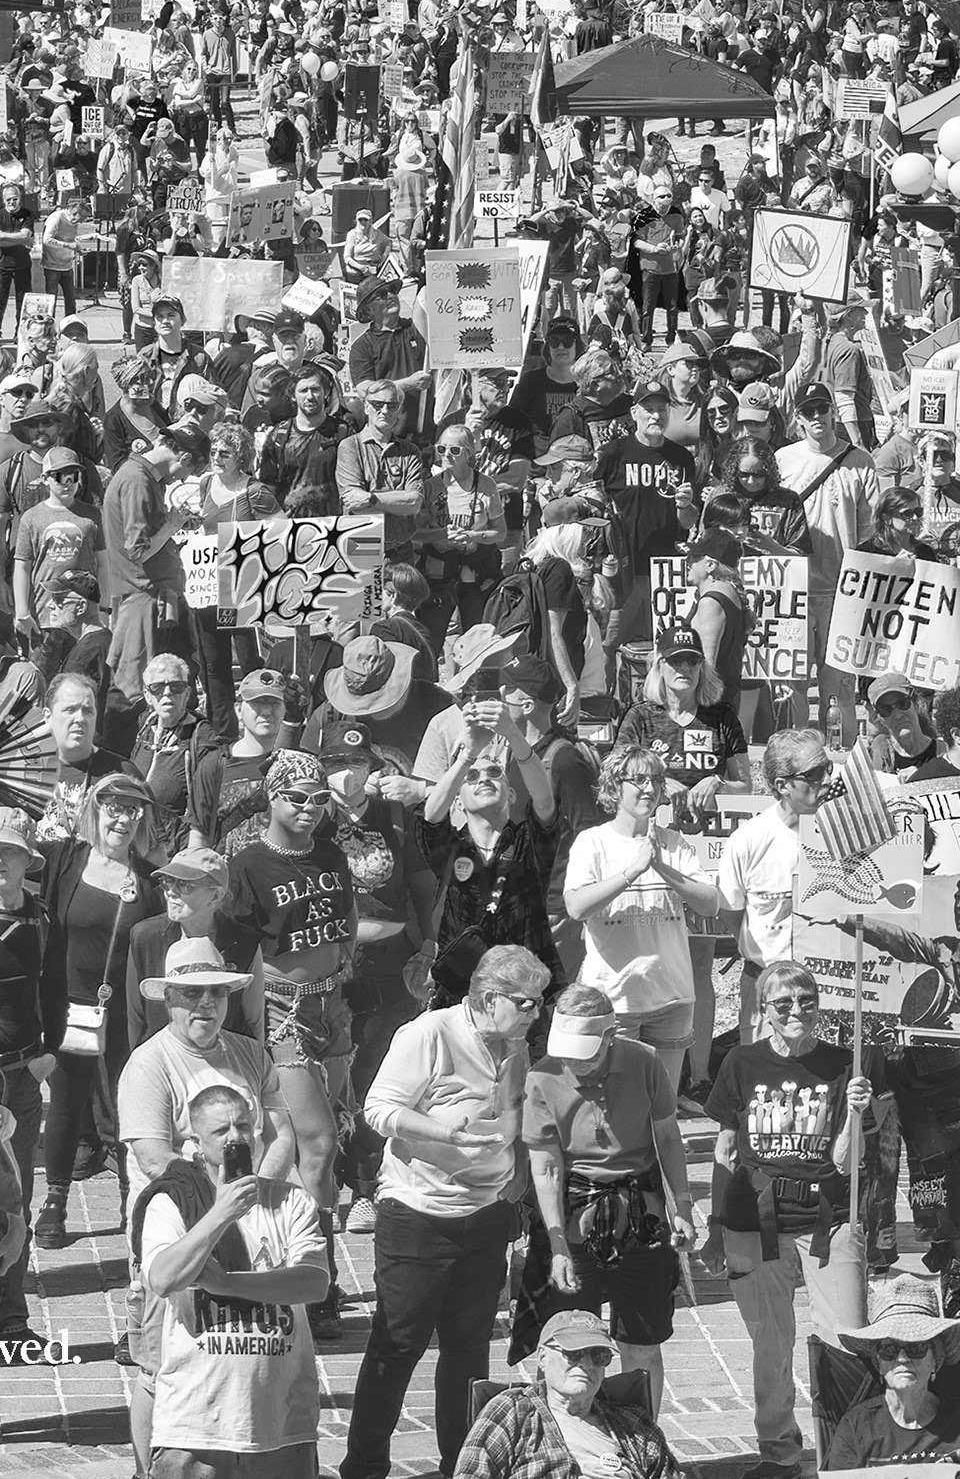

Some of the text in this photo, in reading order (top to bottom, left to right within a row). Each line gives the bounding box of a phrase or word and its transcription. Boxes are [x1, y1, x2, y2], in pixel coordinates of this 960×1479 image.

[112, 12, 142, 24] ENERGY
[492, 53, 525, 62] STOP THE
[492, 72, 508, 80] STOP
[845, 79, 883, 89] AMERICA
[490, 90, 508, 99] STOP
[84, 107, 101, 121] ICE
[480, 193, 515, 204] RESIST
[168, 197, 207, 213] TRUMP
[483, 206, 499, 217] NO
[431, 261, 519, 278] OMG WTF
[431, 272, 450, 282] GOP
[435, 297, 515, 314] 86 47
[924, 408, 939, 416] NO
[188, 568, 206, 580] NO
[189, 583, 218, 594] SINCE
[839, 567, 958, 617] CITIZEN
[653, 587, 687, 616] OF
[220, 609, 234, 617] ICE
[374, 604, 382, 617] LA
[219, 616, 236, 624] OUT
[859, 607, 931, 646] NOT
[649, 738, 671, 754] Be
[271, 872, 344, 907] BLACK
[305, 897, 333, 923] AS
[623, 916, 648, 927] SINCE
[288, 918, 351, 952] FUCK
[749, 1134, 831, 1152] EVERYONE
[764, 1149, 808, 1160] welcome
[207, 1335, 286, 1357] IN AMERICA
